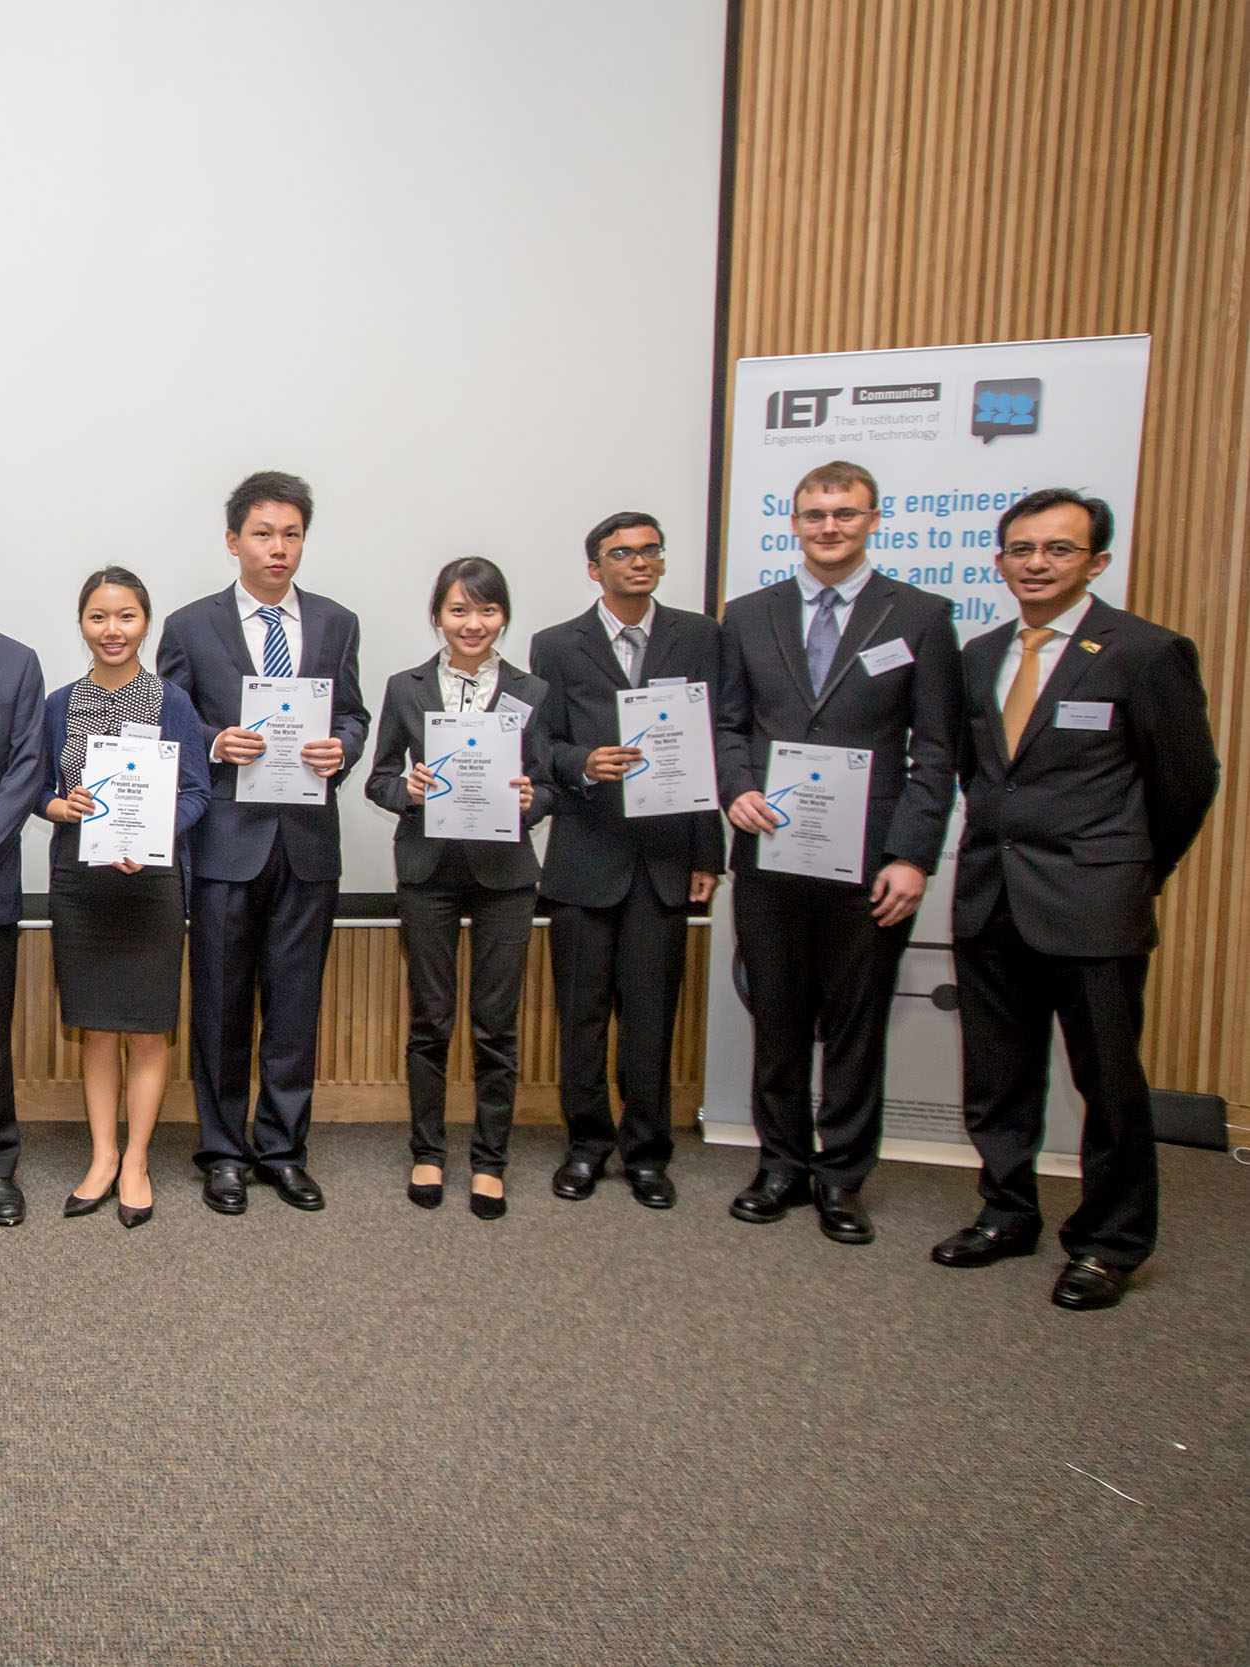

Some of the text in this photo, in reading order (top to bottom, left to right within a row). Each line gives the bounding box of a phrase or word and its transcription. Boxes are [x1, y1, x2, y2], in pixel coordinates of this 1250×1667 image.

[860, 387, 935, 401] Communities
[766, 387, 844, 430] IET
[835, 411, 940, 426] The Institution of
[764, 428, 940, 447] Engineering and Technology
[928, 526, 952, 549] to
[908, 562, 953, 585] and
